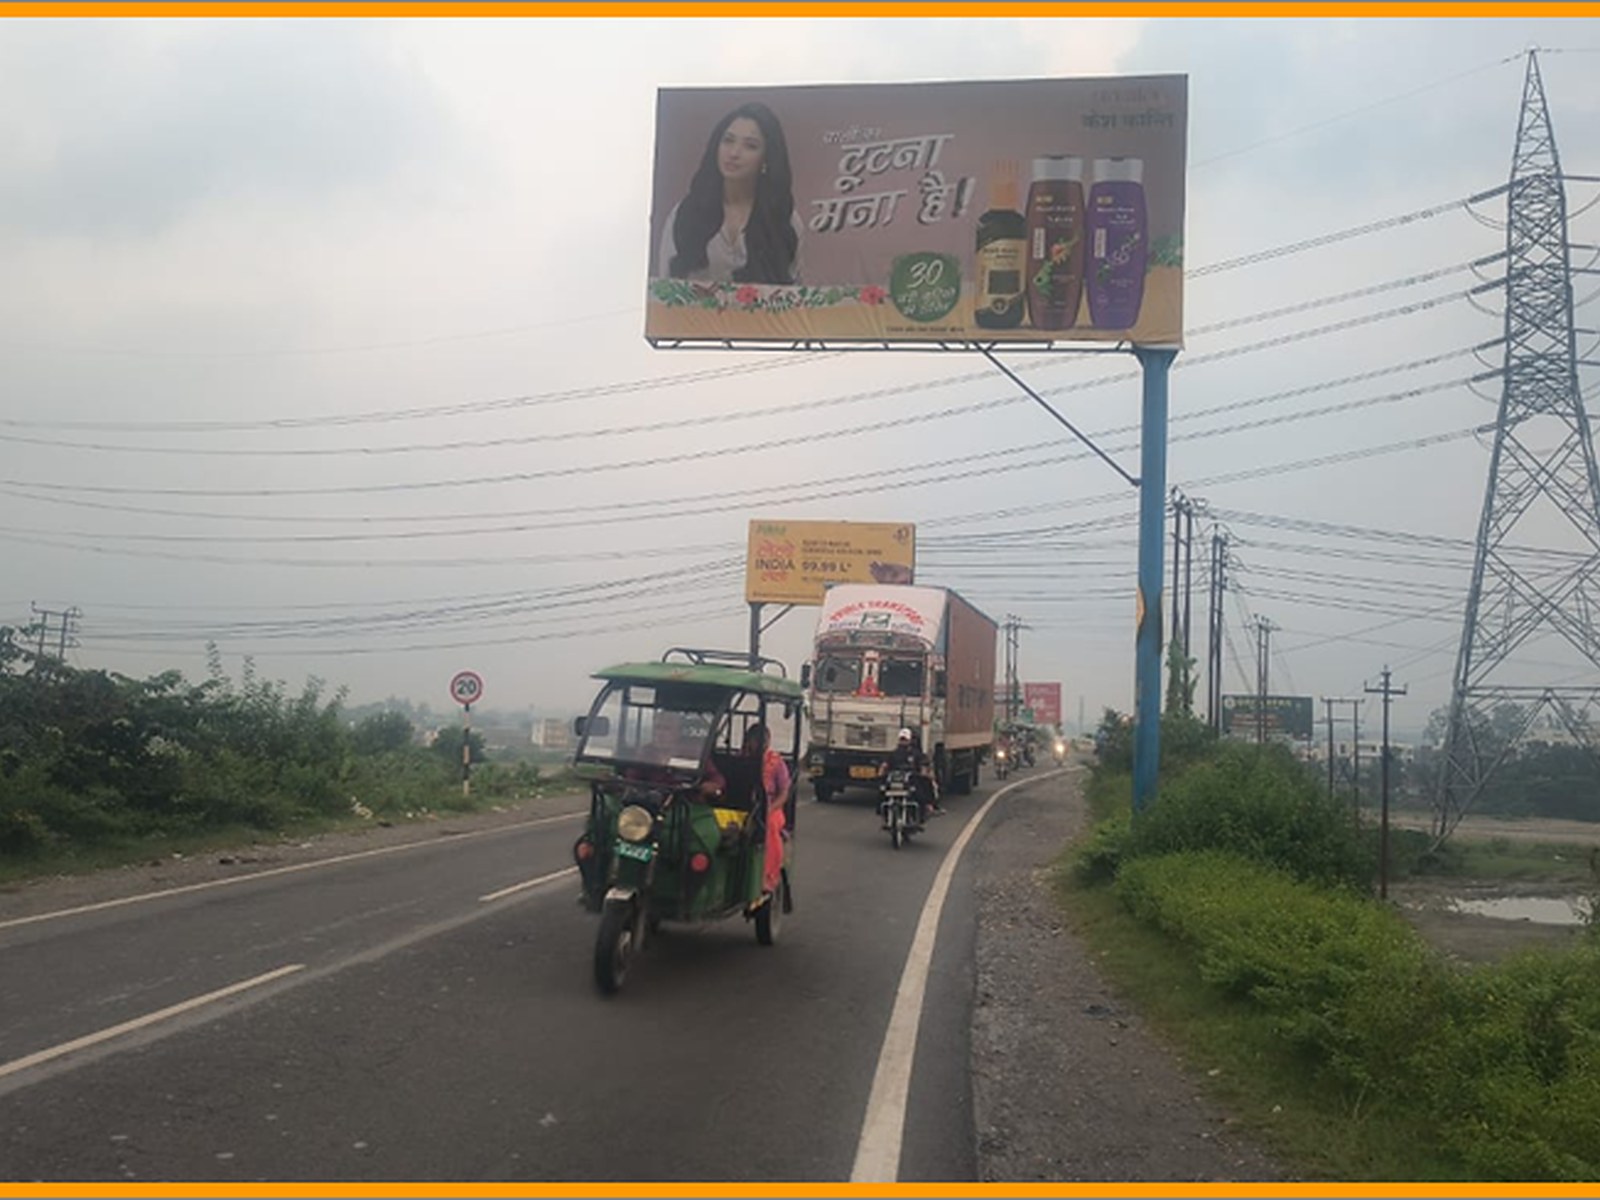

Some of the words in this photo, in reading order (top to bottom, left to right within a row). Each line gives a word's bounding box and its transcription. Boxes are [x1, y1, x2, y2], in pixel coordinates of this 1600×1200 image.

[834, 134, 955, 193] टूटना
[808, 190, 908, 232] मना
[916, 170, 976, 226] है!
[906, 259, 944, 288] 30
[755, 558, 796, 571] INDIA
[456, 679, 477, 695] 20
